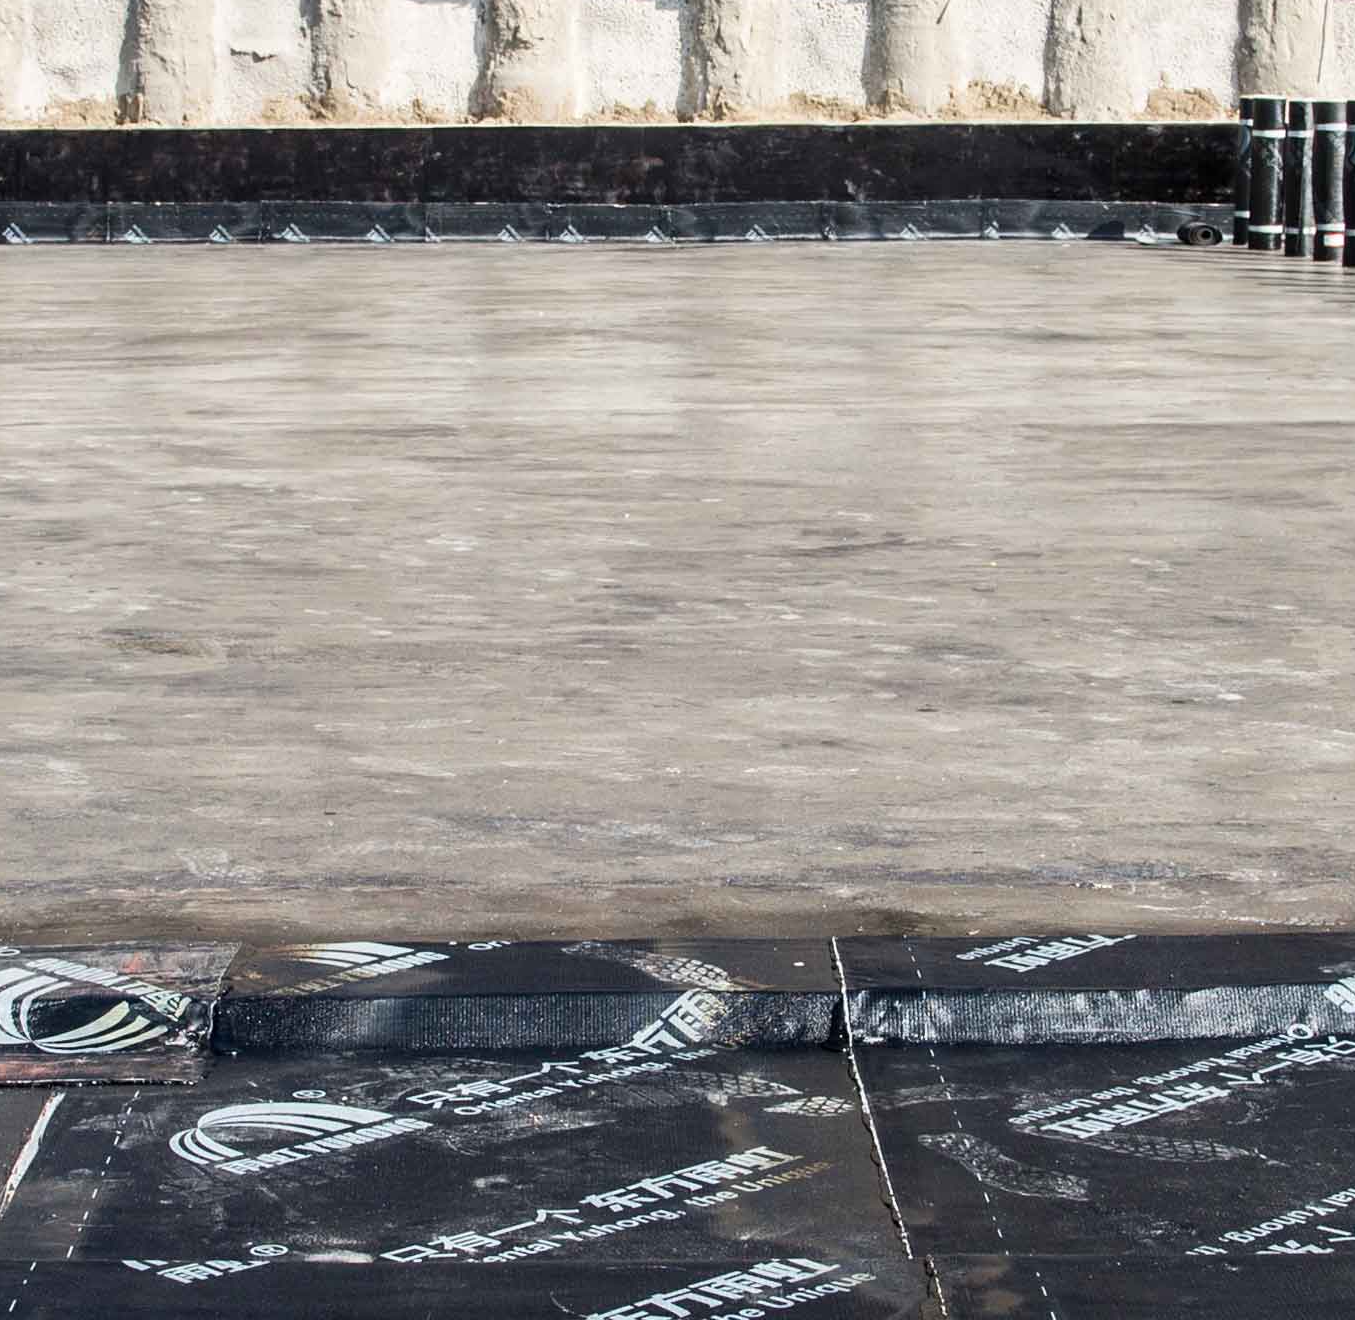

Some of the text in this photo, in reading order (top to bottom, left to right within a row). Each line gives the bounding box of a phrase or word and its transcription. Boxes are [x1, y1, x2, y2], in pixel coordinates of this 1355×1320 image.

[984, 934, 1138, 972] 方雨虹
[1007, 1022, 1314, 1126] Oriental Yuhong, the Unique
[453, 1085, 563, 1116] Oriental
[214, 1117, 435, 1175] 雨虹 YUHONG
[555, 1206, 687, 1244] Yuhong,
[683, 1187, 741, 1209] the
[738, 1160, 836, 1193] Unique
[1217, 1203, 1337, 1244] Yuhong,
[757, 1270, 878, 1311] Unique
